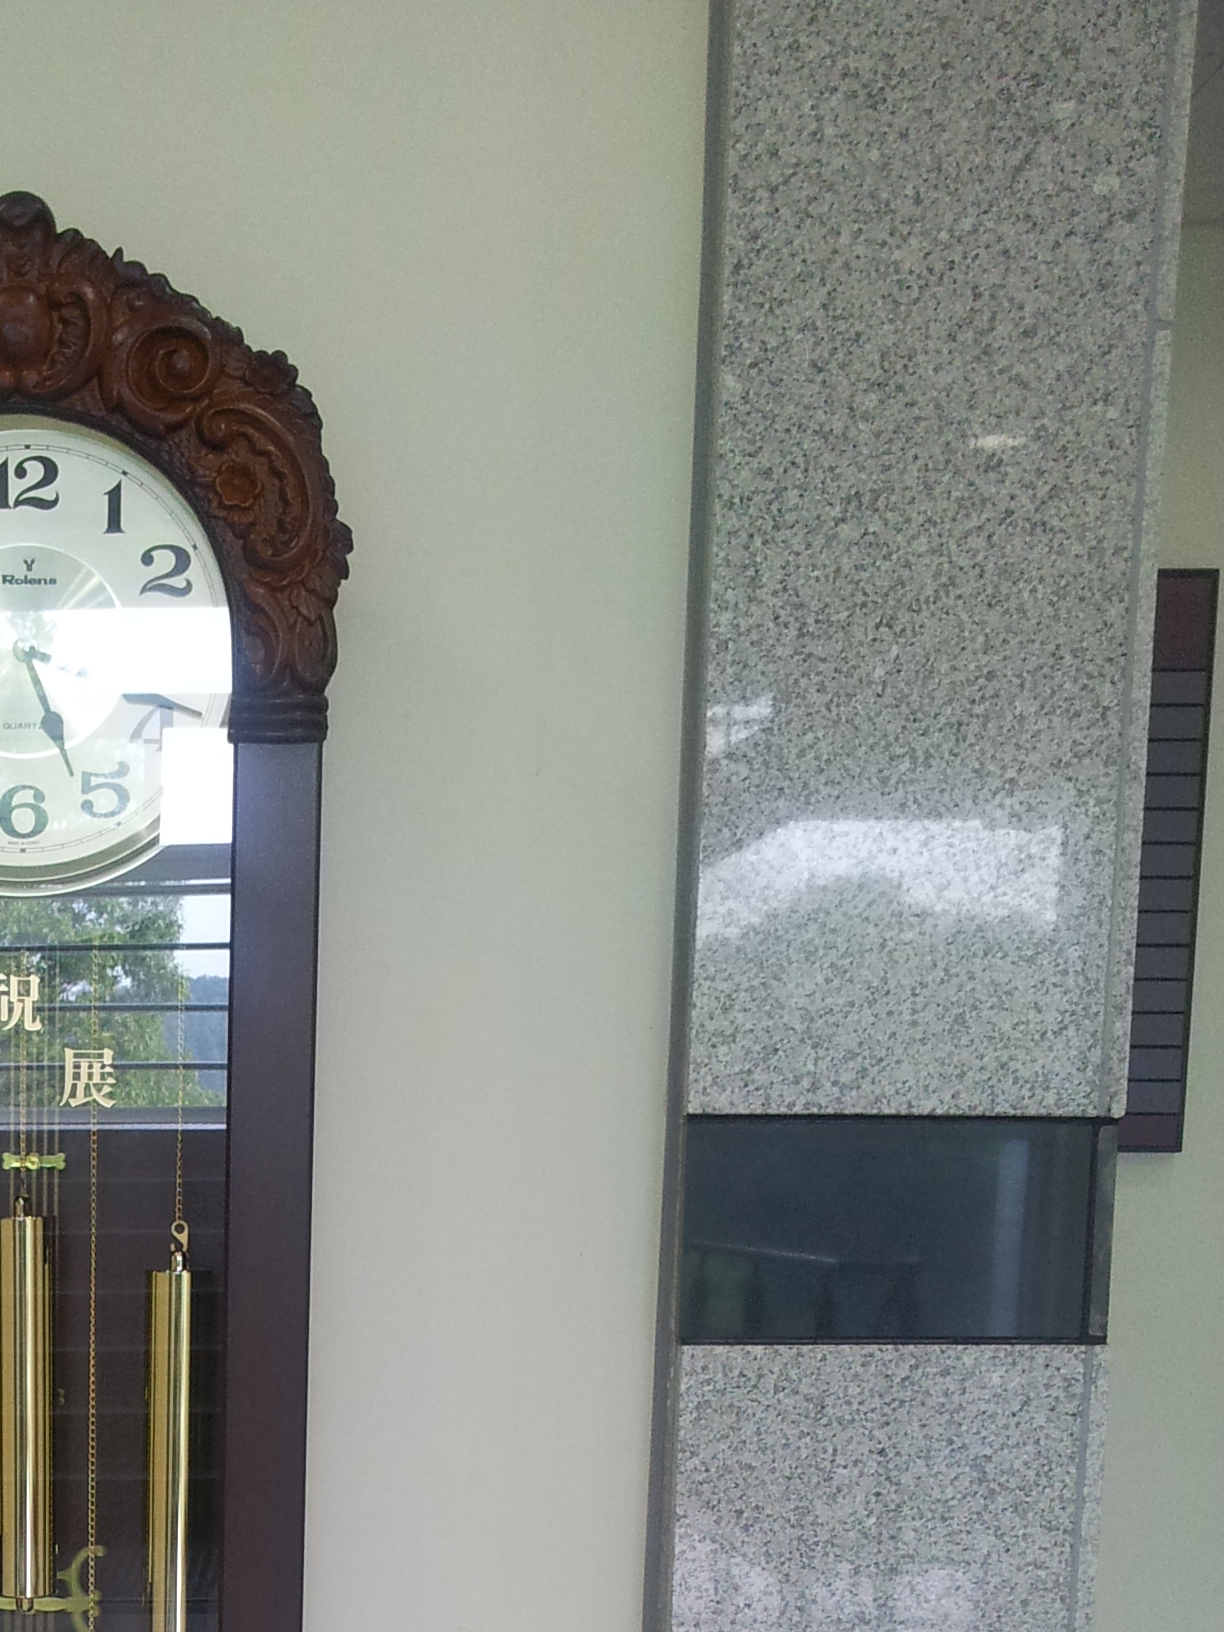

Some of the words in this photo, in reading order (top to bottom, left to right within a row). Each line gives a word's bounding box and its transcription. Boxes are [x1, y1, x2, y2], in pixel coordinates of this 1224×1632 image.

[102, 479, 126, 534] 1
[139, 544, 194, 598] 2
[81, 761, 131, 820] 5
